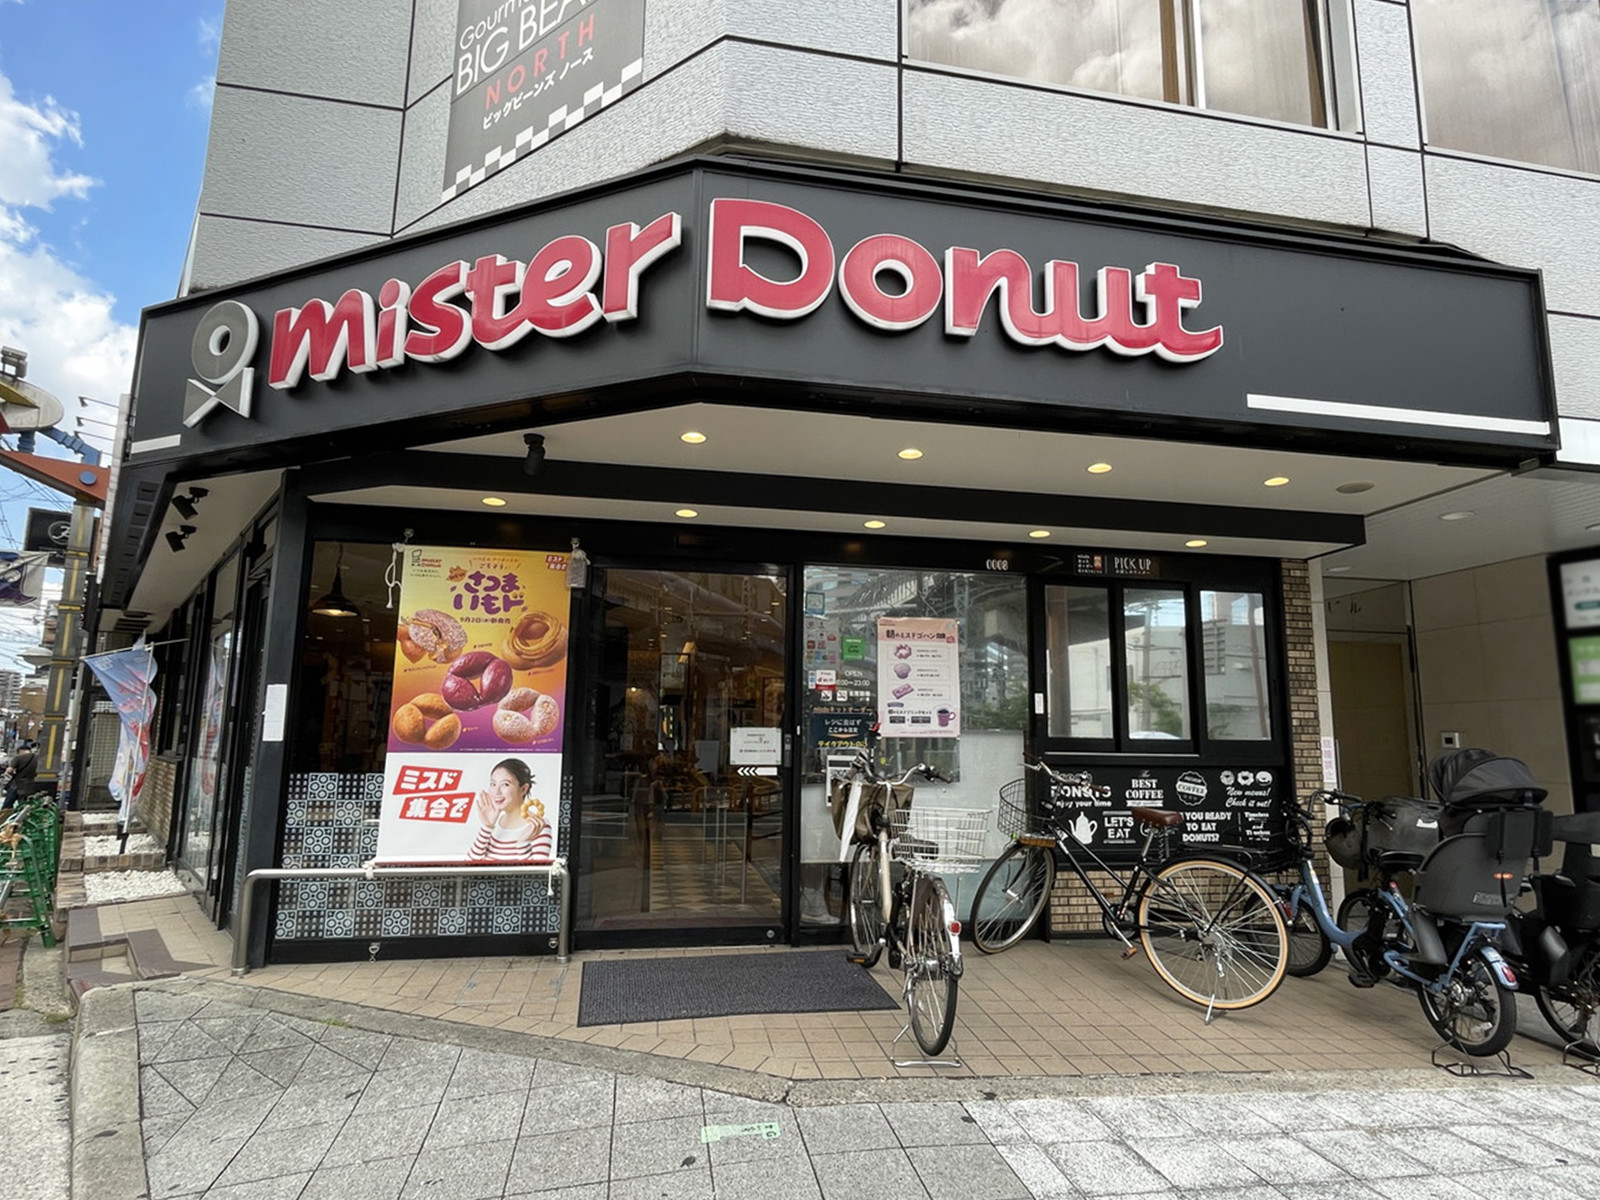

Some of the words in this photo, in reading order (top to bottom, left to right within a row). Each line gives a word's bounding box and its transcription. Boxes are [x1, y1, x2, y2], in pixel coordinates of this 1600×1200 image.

[460, 0, 529, 50] Gourm
[457, 26, 510, 95] BIG
[485, 13, 596, 110] NORTH
[559, 47, 594, 80] ノース
[706, 198, 1224, 363] Donut
[1114, 556, 1137, 570] PICK
[1138, 558, 1152, 571] UP
[464, 570, 520, 593] さつま
[453, 592, 524, 615] いもド
[401, 769, 458, 791] ミスド
[1131, 778, 1158, 789] BEST
[1125, 789, 1164, 799] COFFEE
[1178, 783, 1205, 795] COFFEE
[1226, 786, 1243, 796] New
[405, 797, 470, 819] 集合で
[1225, 797, 1247, 807] Check
[1248, 799, 1256, 807] it
[1256, 799, 1272, 807] out!
[1104, 816, 1134, 827] LET'S
[1184, 811, 1203, 820] YOU
[1204, 811, 1232, 820] READY
[1186, 822, 1199, 831] TO
[1200, 822, 1217, 831] EAT
[1107, 828, 1131, 839] EAT
[1182, 833, 1220, 842] DONUTS?
